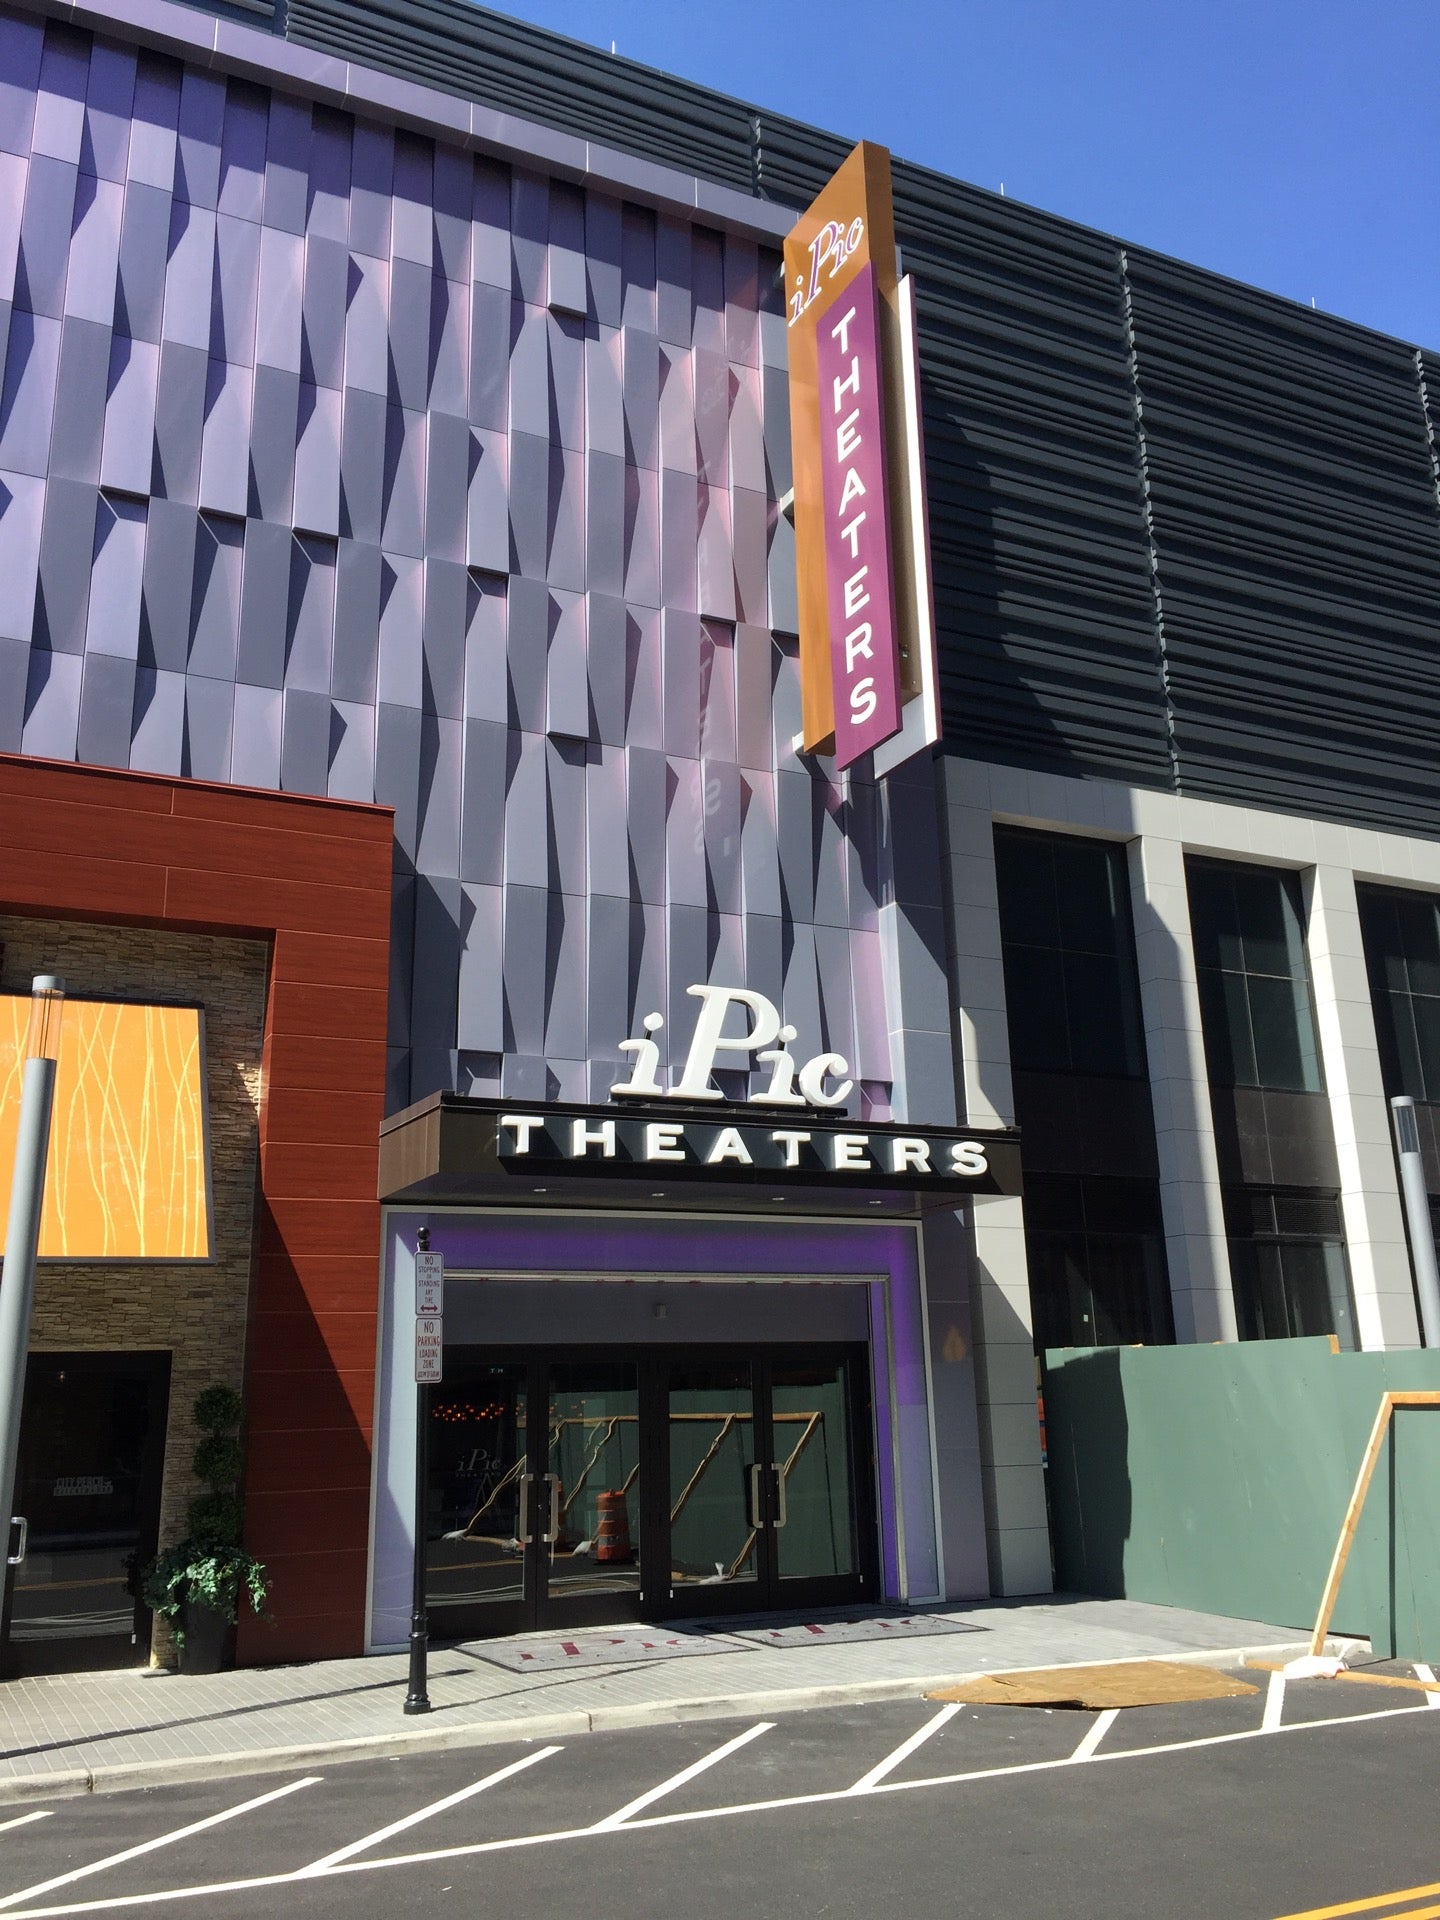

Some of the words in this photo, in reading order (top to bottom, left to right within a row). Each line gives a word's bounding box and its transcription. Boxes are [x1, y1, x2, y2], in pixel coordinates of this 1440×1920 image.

[788, 216, 864, 328] iPic
[831, 306, 877, 726] THEATERS
[610, 983, 854, 1107] iPic
[500, 1114, 988, 1177] THEATERS
[424, 1255, 434, 1265] NO
[418, 1265, 440, 1273] STOPPING
[418, 1279, 440, 1288] STANDING
[424, 1320, 434, 1334] NO
[418, 1335, 440, 1348] PARKING
[419, 1348, 438, 1359] LOADING
[423, 1360, 434, 1368] ZONE
